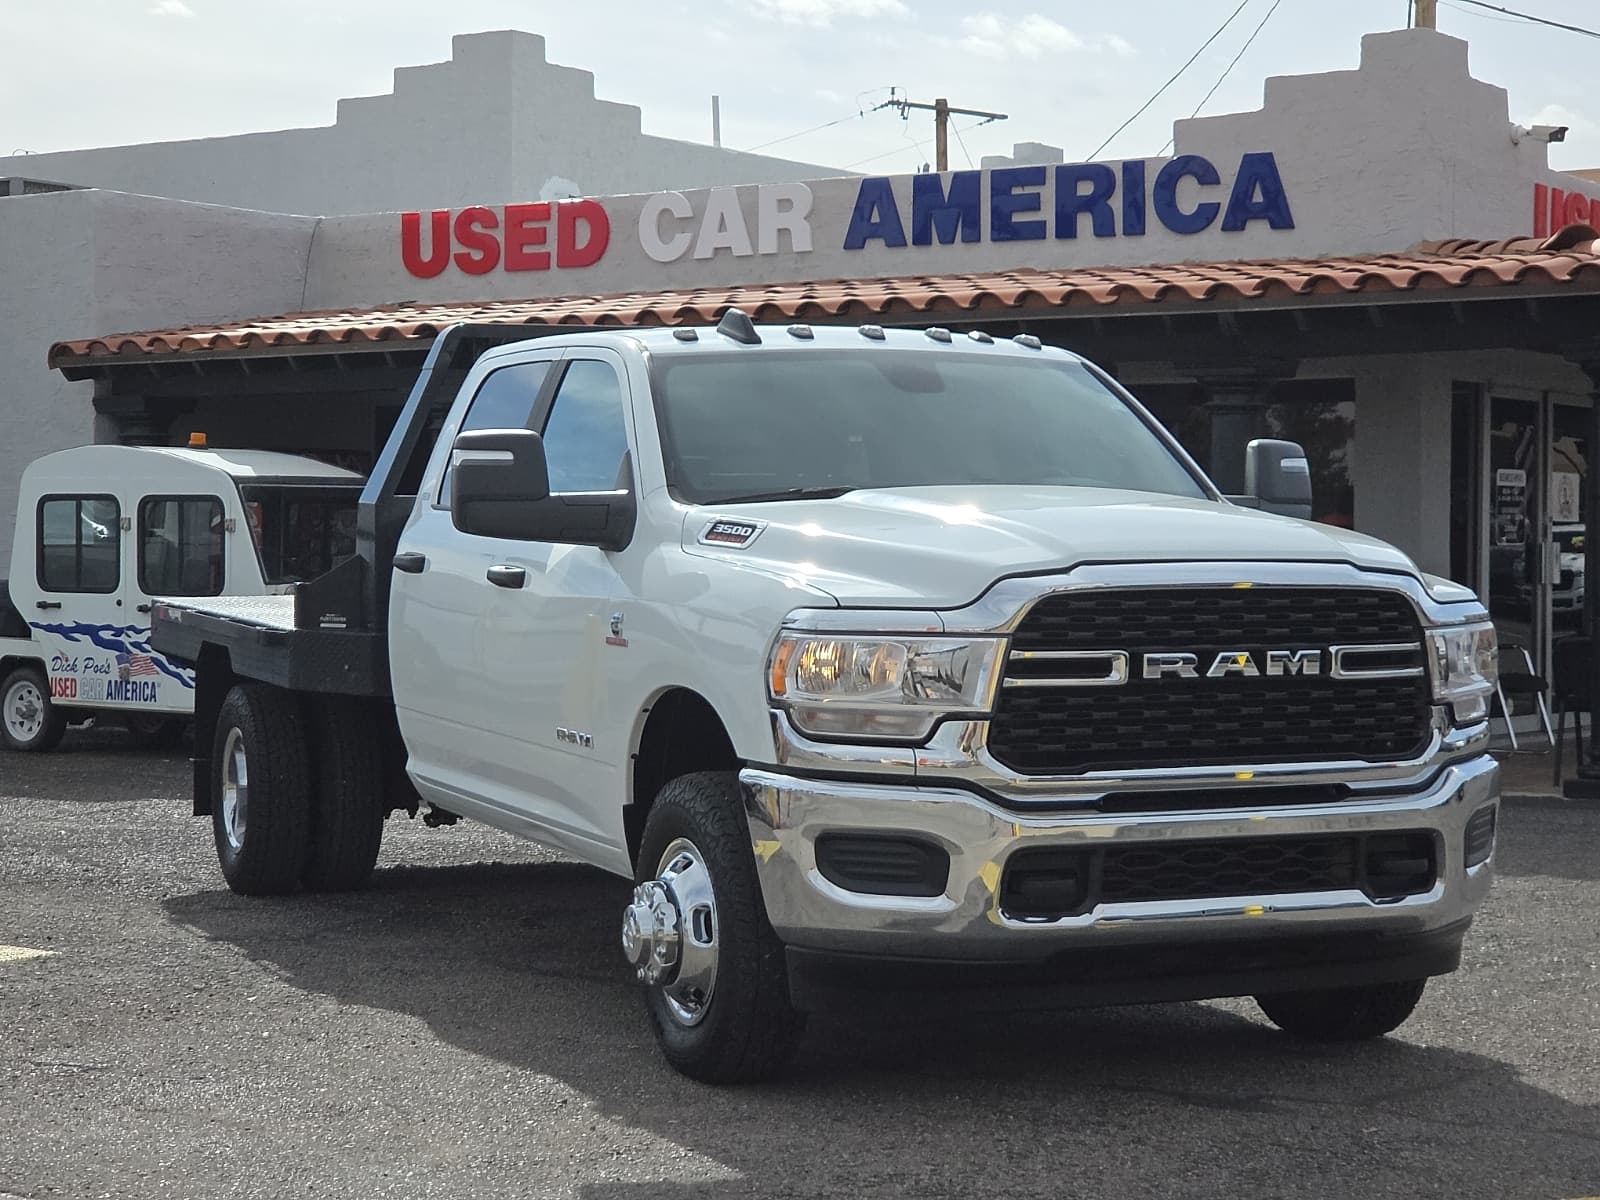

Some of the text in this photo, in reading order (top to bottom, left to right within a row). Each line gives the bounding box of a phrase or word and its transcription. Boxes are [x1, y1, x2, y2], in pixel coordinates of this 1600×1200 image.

[401, 152, 1295, 279] USED CAR AMERICA
[713, 523, 753, 536] 3500
[51, 656, 112, 674] Dick Poe's
[1143, 650, 1321, 679] RAM
[50, 677, 157, 703] USED CAR AMERICA
[556, 728, 594, 748] RAM
